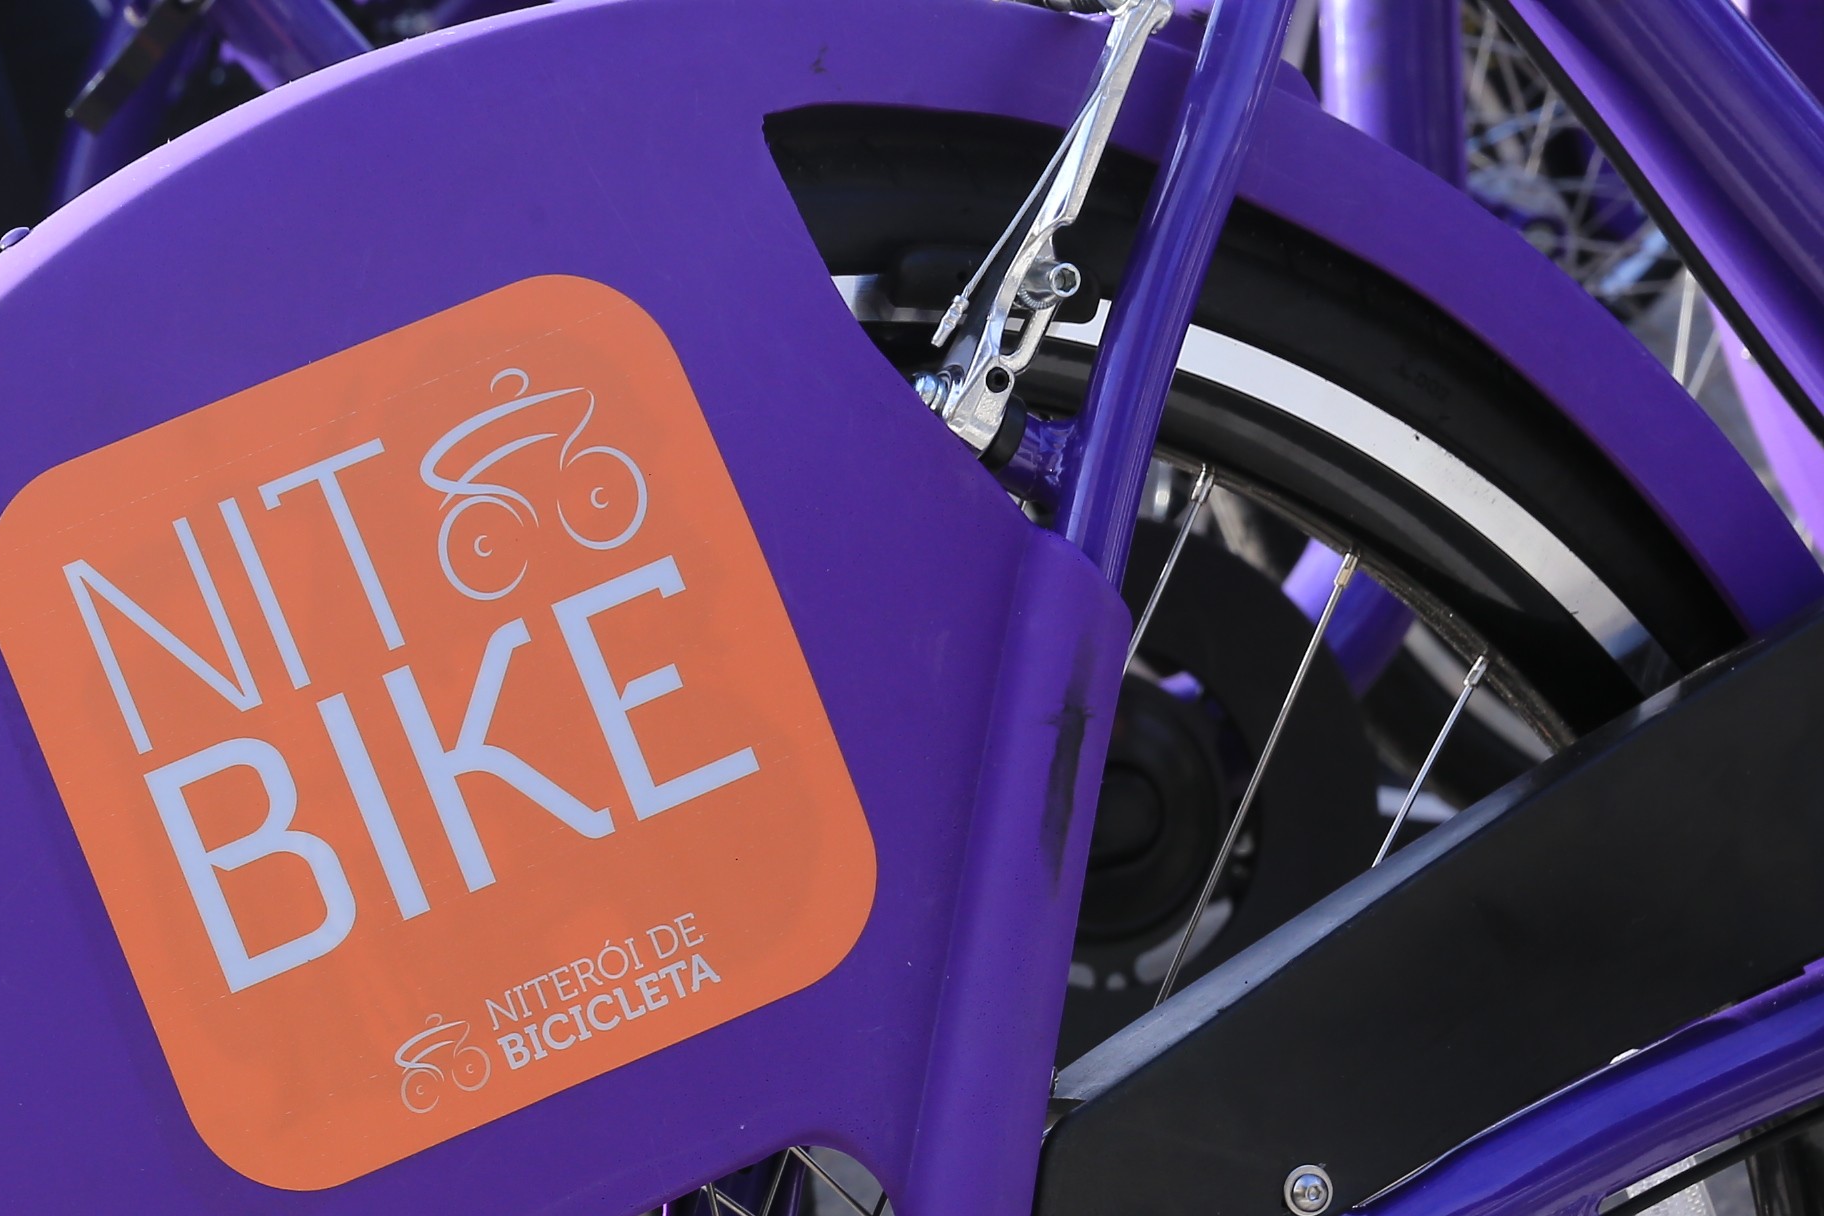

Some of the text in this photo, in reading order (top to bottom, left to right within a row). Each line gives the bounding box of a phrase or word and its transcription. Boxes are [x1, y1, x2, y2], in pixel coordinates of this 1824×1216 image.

[62, 437, 405, 755] NIT
[143, 556, 760, 993] BIKE
[485, 912, 705, 1031] NITERÓI DE
[497, 953, 722, 1071] BICICLETA
